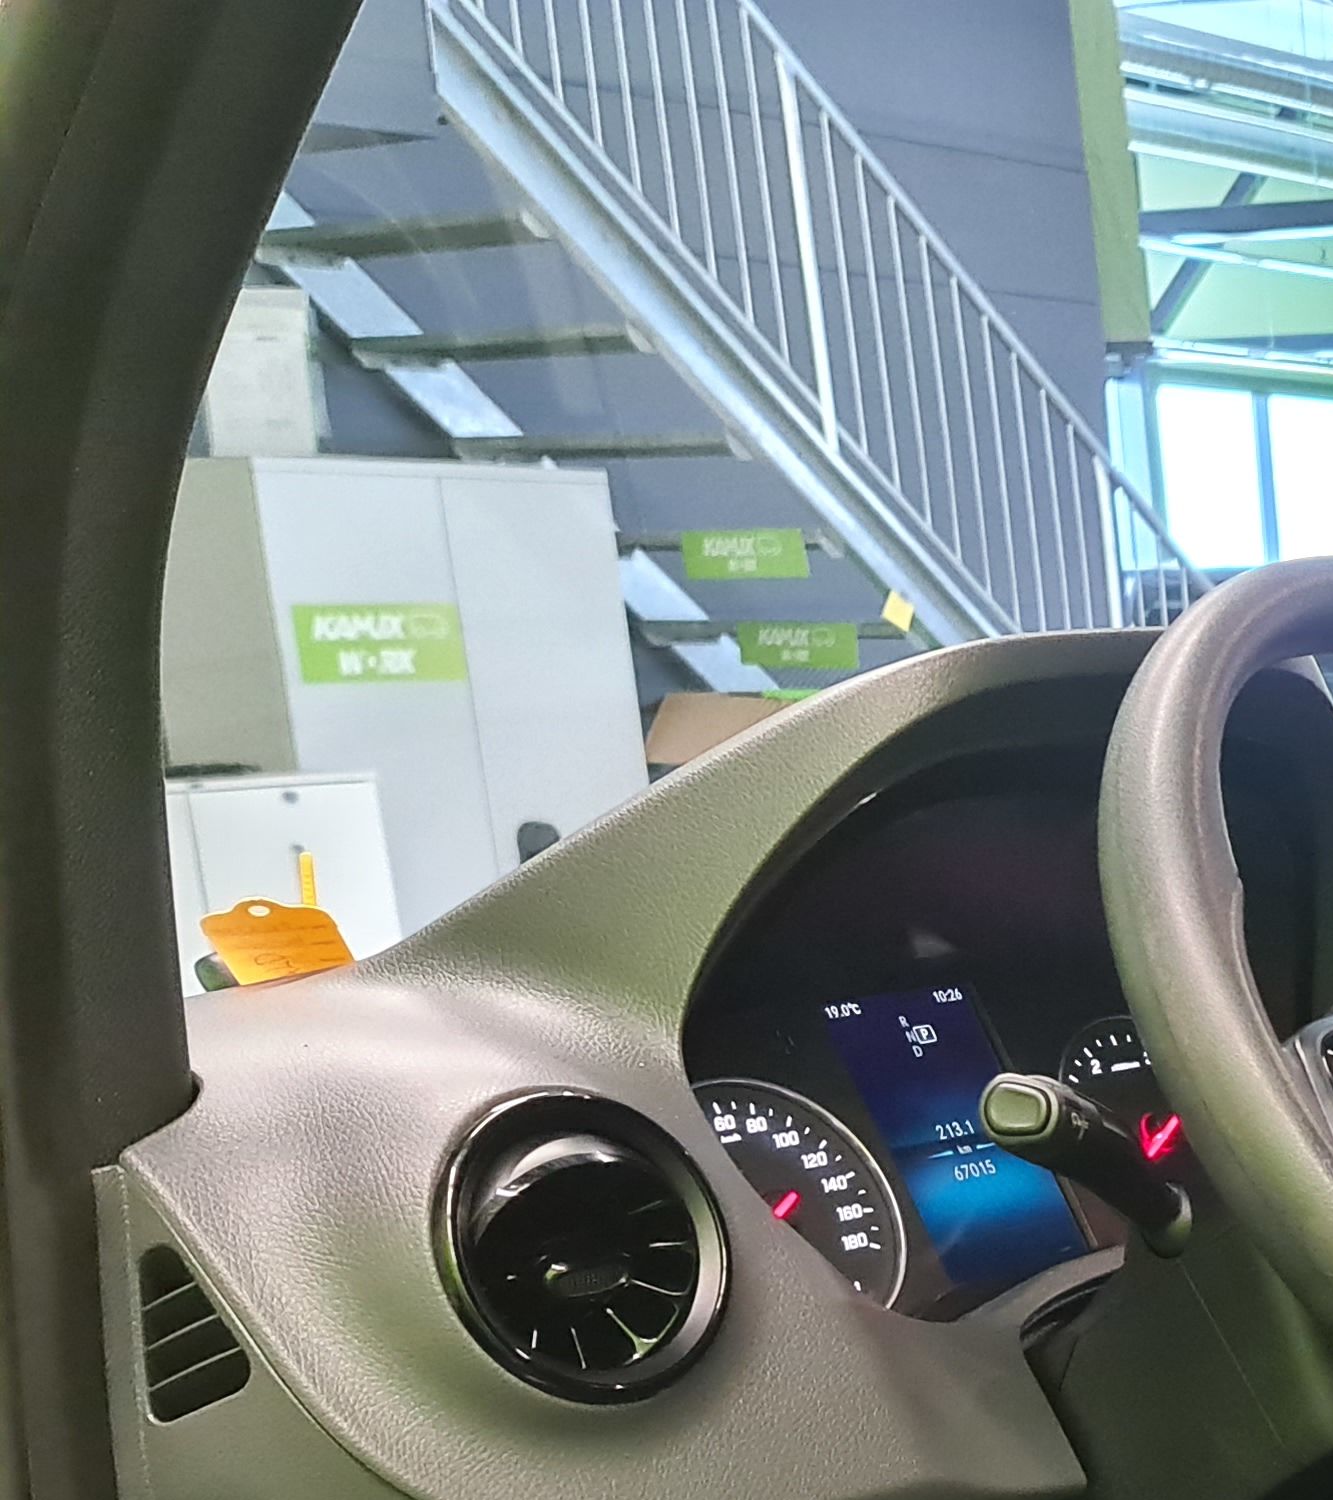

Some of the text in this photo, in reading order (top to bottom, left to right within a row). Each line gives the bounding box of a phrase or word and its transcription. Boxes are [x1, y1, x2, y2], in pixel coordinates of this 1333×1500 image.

[898, 1015, 910, 1028] R
[912, 1045, 923, 1058] D
[1090, 1058, 1103, 1075] 2
[714, 1114, 736, 1132] 60
[746, 1116, 767, 1133] 80
[935, 1119, 975, 1140] 213.1
[772, 1130, 800, 1148] 100
[801, 1150, 828, 1169] 120
[954, 1159, 997, 1181] 67015
[821, 1175, 848, 1193] 140
[836, 1203, 863, 1222] 160
[841, 1232, 868, 1251] 180
